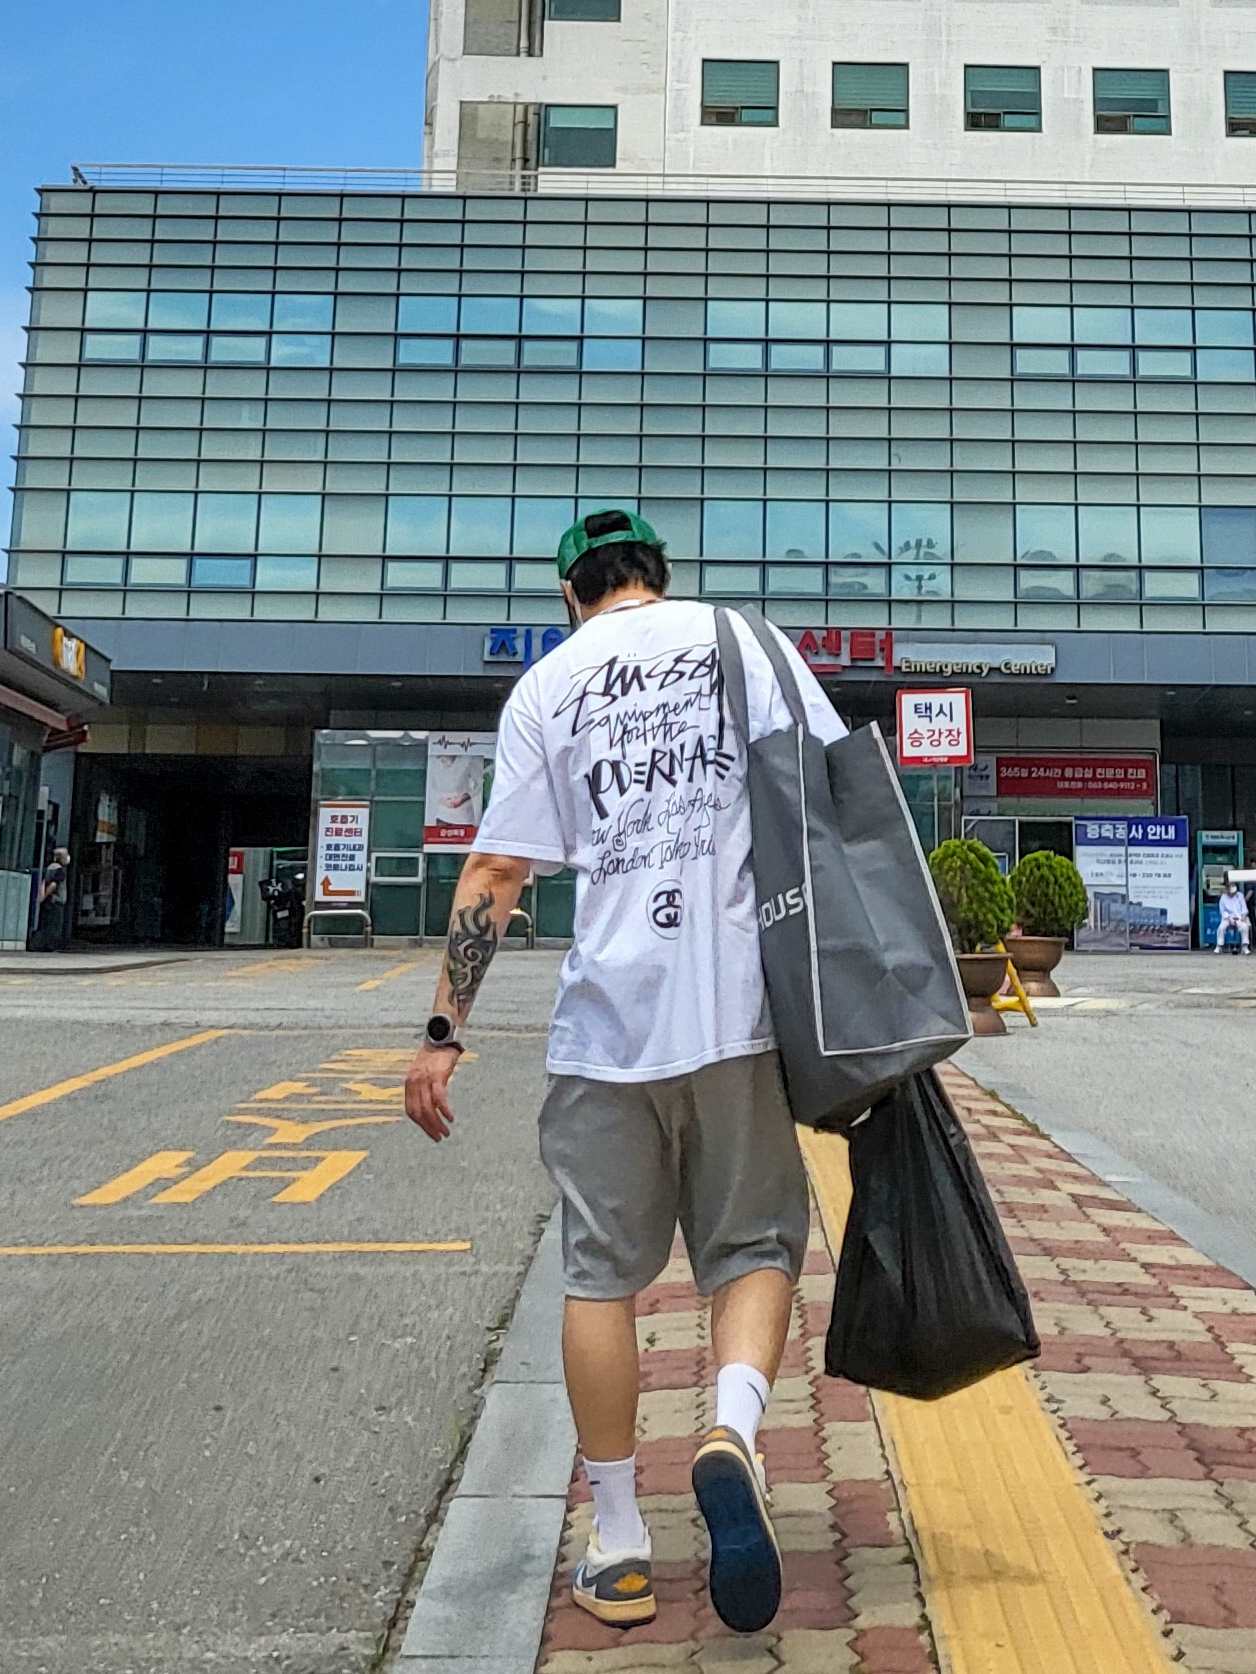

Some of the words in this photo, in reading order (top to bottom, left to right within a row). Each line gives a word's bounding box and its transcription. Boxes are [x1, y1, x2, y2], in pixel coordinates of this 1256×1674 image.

[900, 657, 990, 677] Emergency
[999, 659, 1055, 675] Center
[914, 701, 954, 724] 택시
[907, 727, 963, 748] 승강장
[1000, 767, 1029, 778] 365일
[1031, 767, 1061, 778] 24시간
[329, 814, 359, 824] 호흡기
[324, 827, 363, 837] 진료센터
[1147, 824, 1175, 841] 안내
[591, 847, 655, 885] London
[758, 882, 809, 931] OUS
